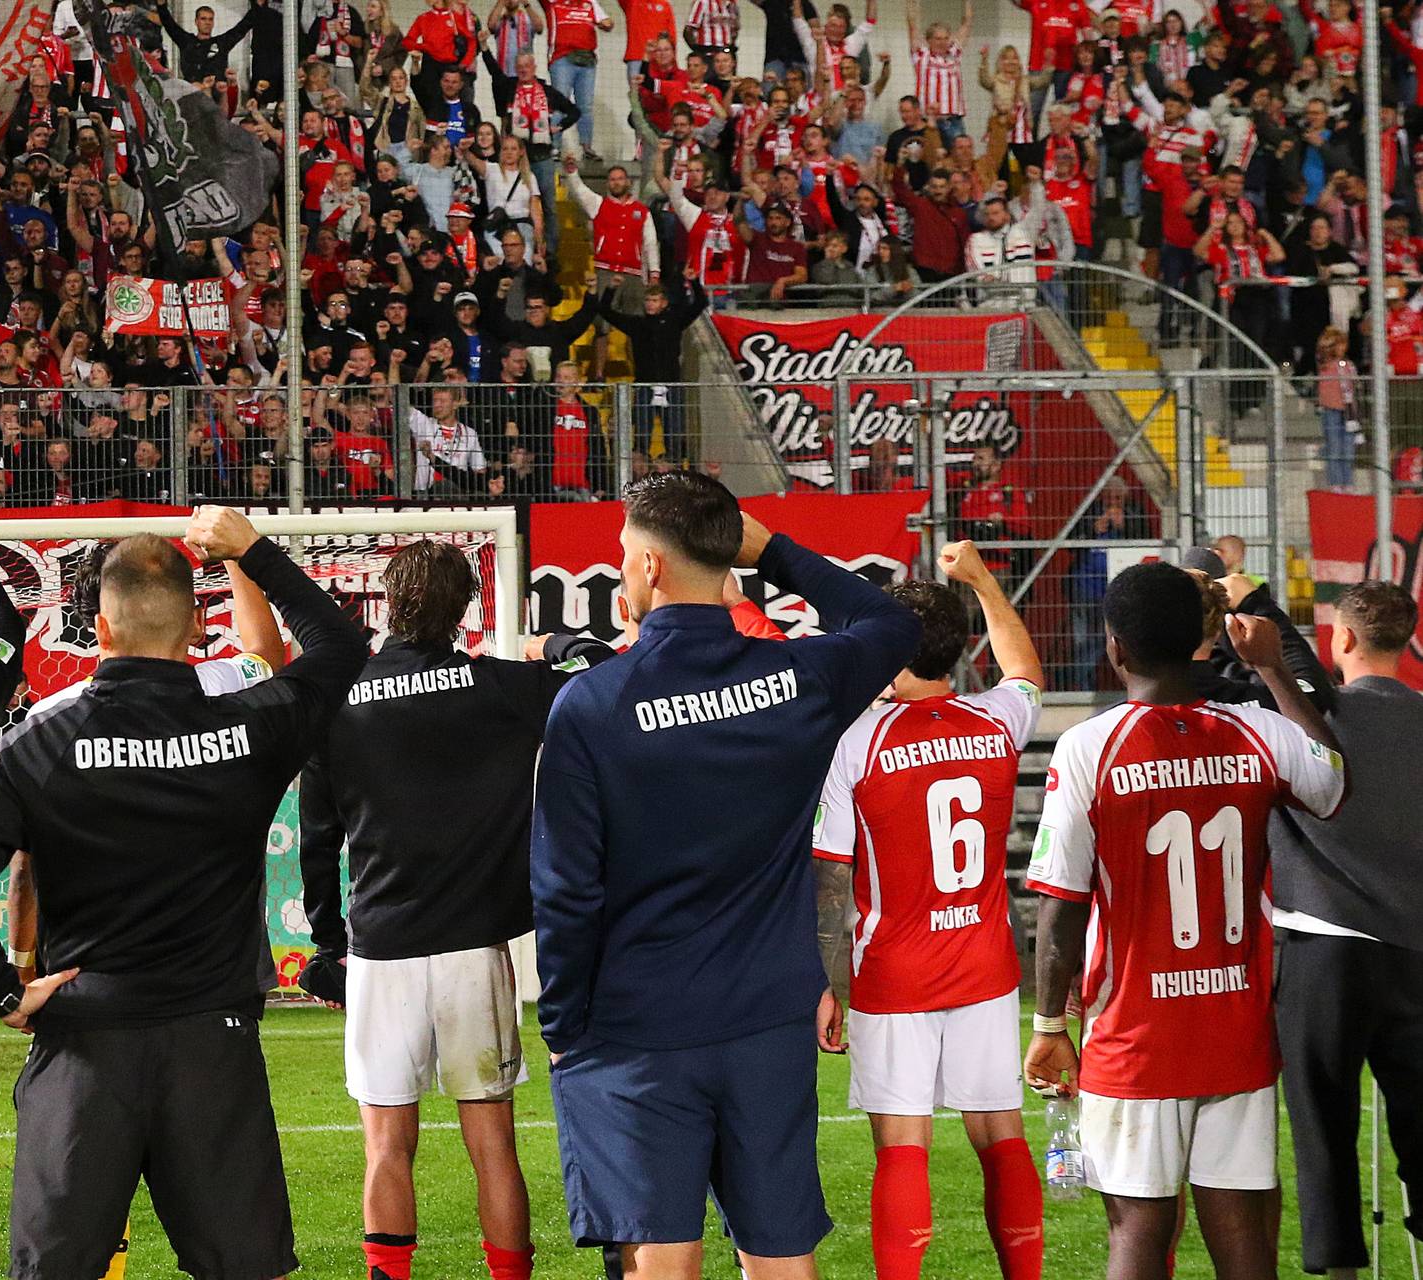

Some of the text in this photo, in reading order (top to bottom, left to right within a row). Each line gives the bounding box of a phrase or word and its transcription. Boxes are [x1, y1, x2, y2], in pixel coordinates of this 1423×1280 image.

[347, 663, 475, 706] OBERHAUSEN
[635, 668, 798, 732] OBERHAUSEN
[74, 724, 251, 770] OBERHAUSEN
[878, 733, 1008, 775] OBERHAUSEN
[1110, 754, 1262, 796] OBERHAUSEN
[926, 775, 986, 894] 6
[1145, 805, 1244, 950] 11
